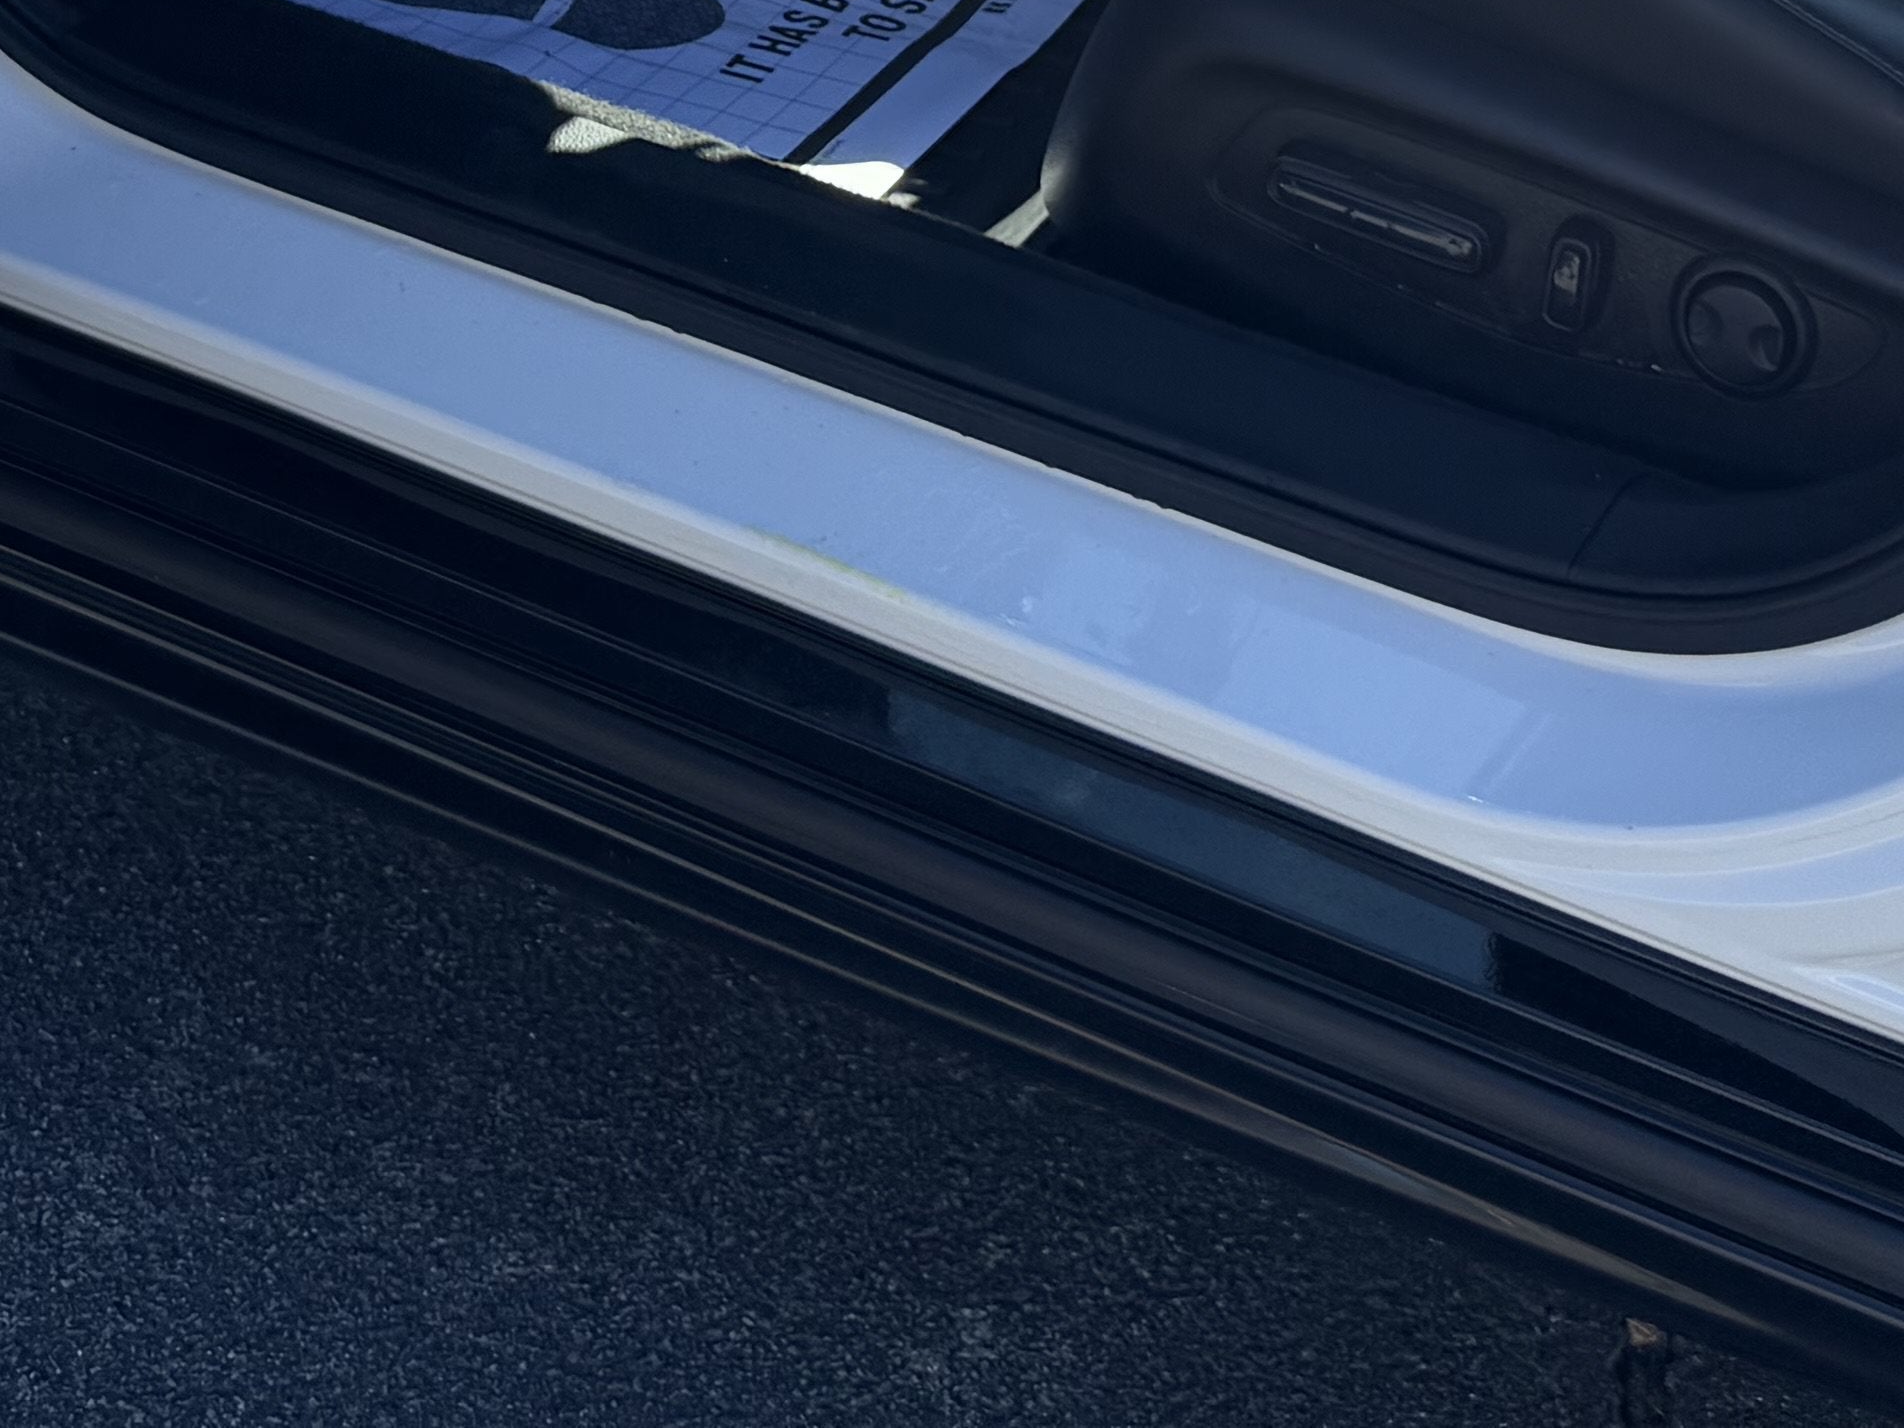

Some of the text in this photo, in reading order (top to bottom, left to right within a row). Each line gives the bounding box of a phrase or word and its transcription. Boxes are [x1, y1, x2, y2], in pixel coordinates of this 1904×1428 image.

[720, 54, 775, 83] IT
[748, 9, 829, 56] HAS
[842, 13, 907, 42] TO
